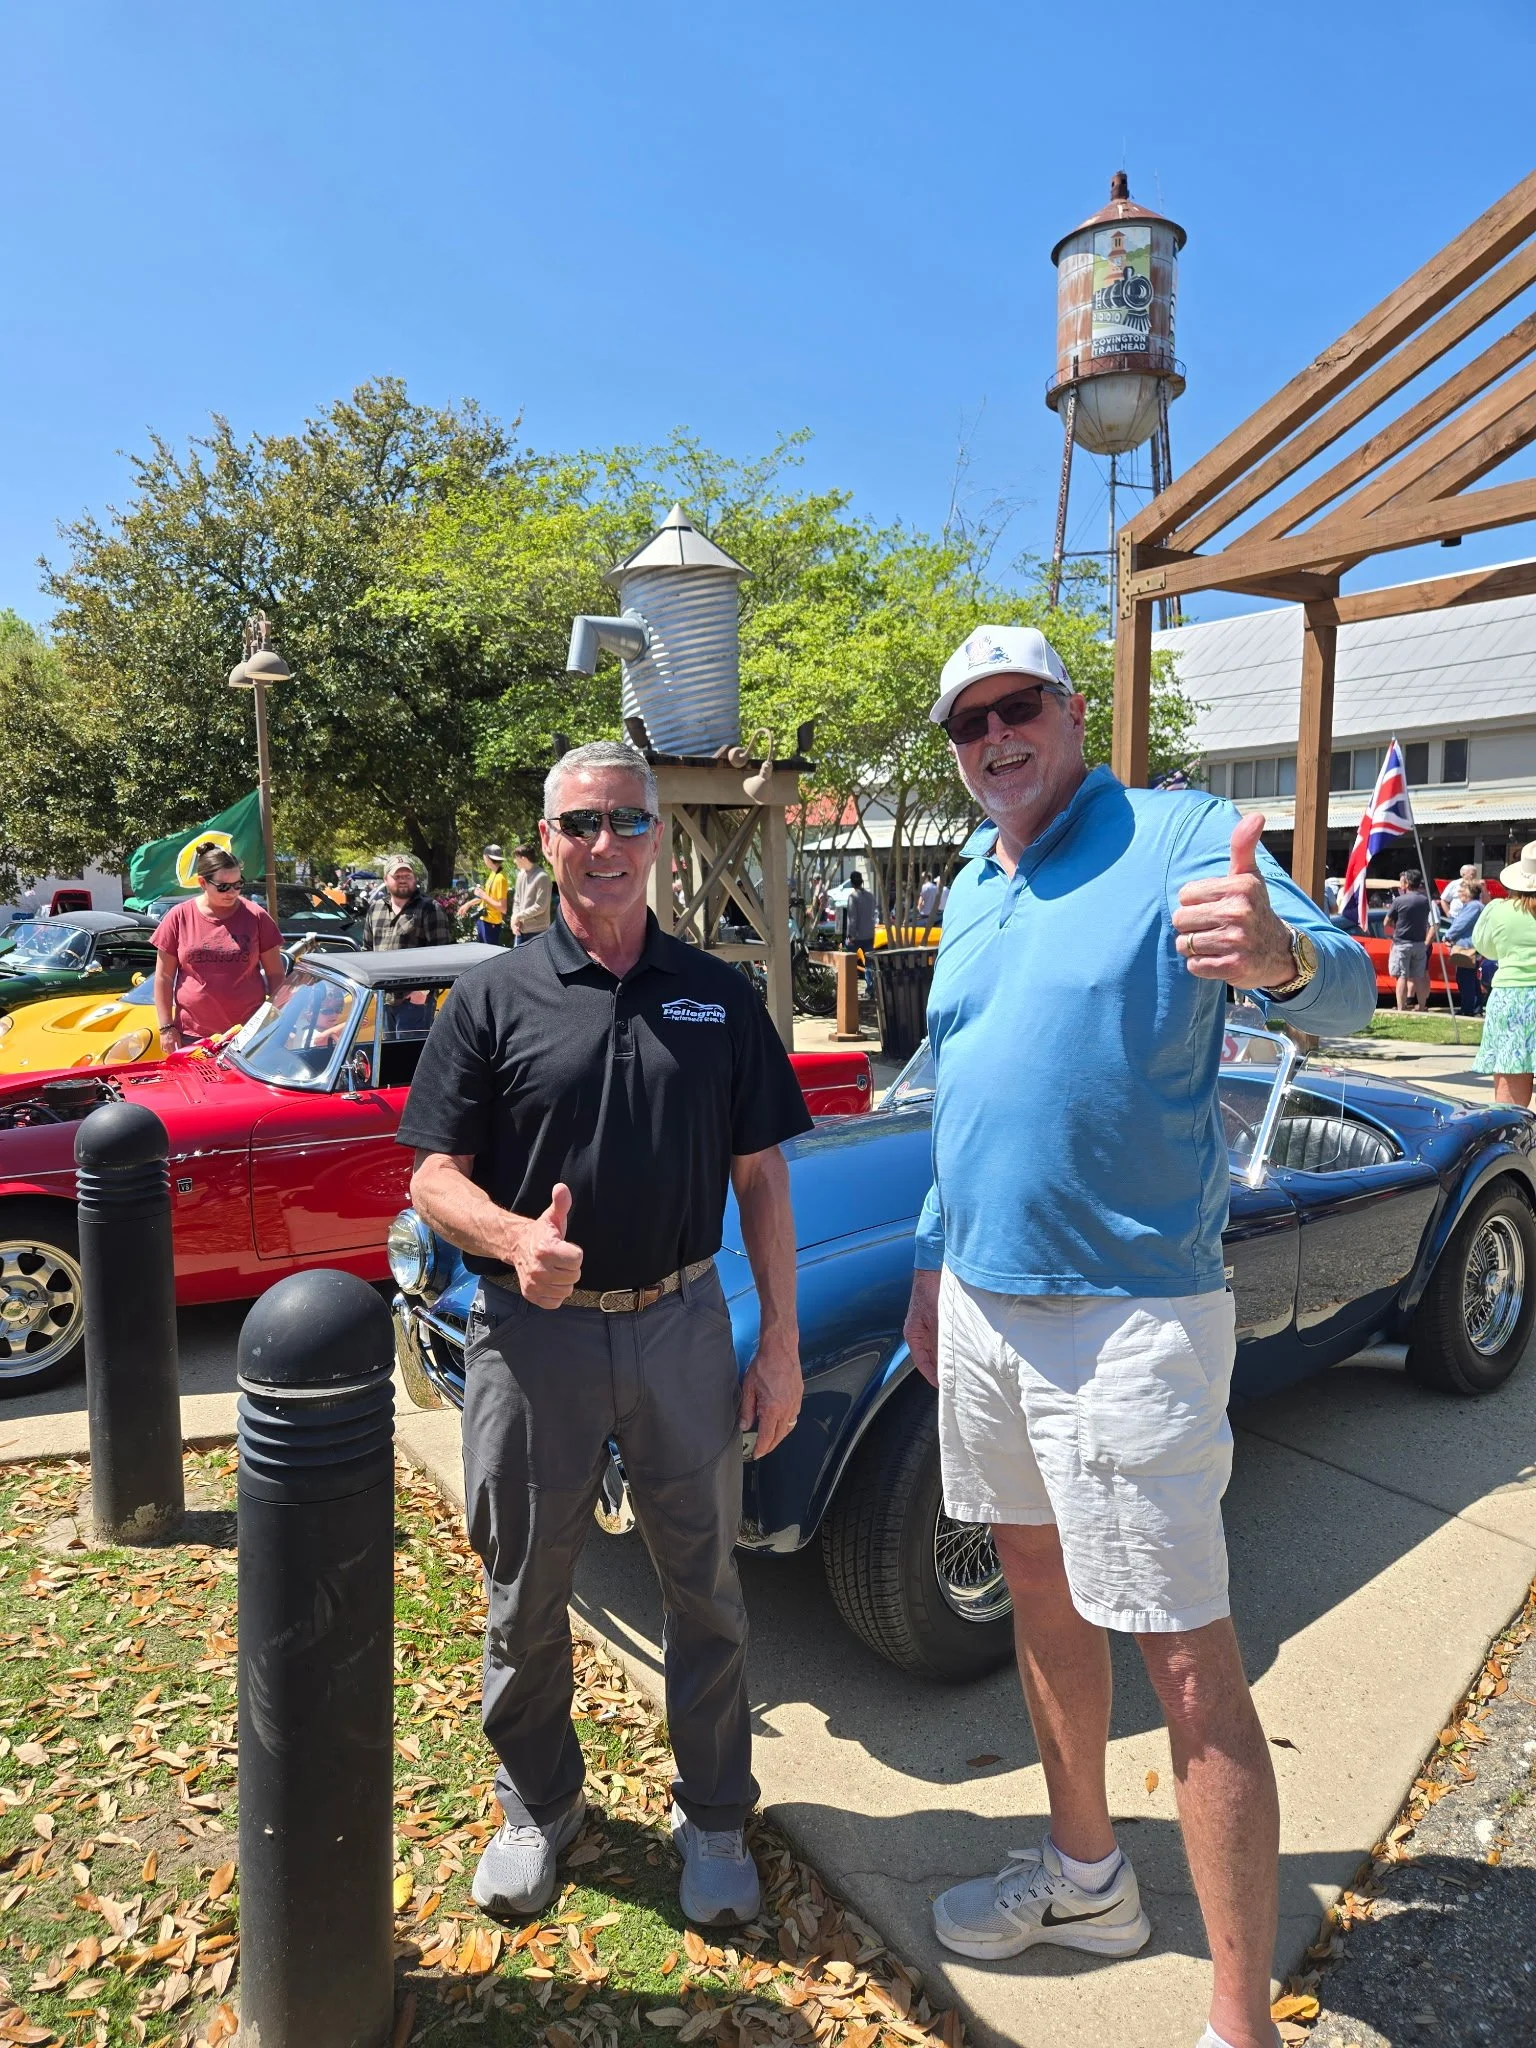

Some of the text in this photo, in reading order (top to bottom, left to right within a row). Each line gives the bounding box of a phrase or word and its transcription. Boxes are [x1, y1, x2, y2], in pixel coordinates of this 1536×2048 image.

[1093, 334, 1146, 347] COVINGTON
[1093, 343, 1146, 356] TRAILHEAD
[186, 948, 250, 962] PEANUTS
